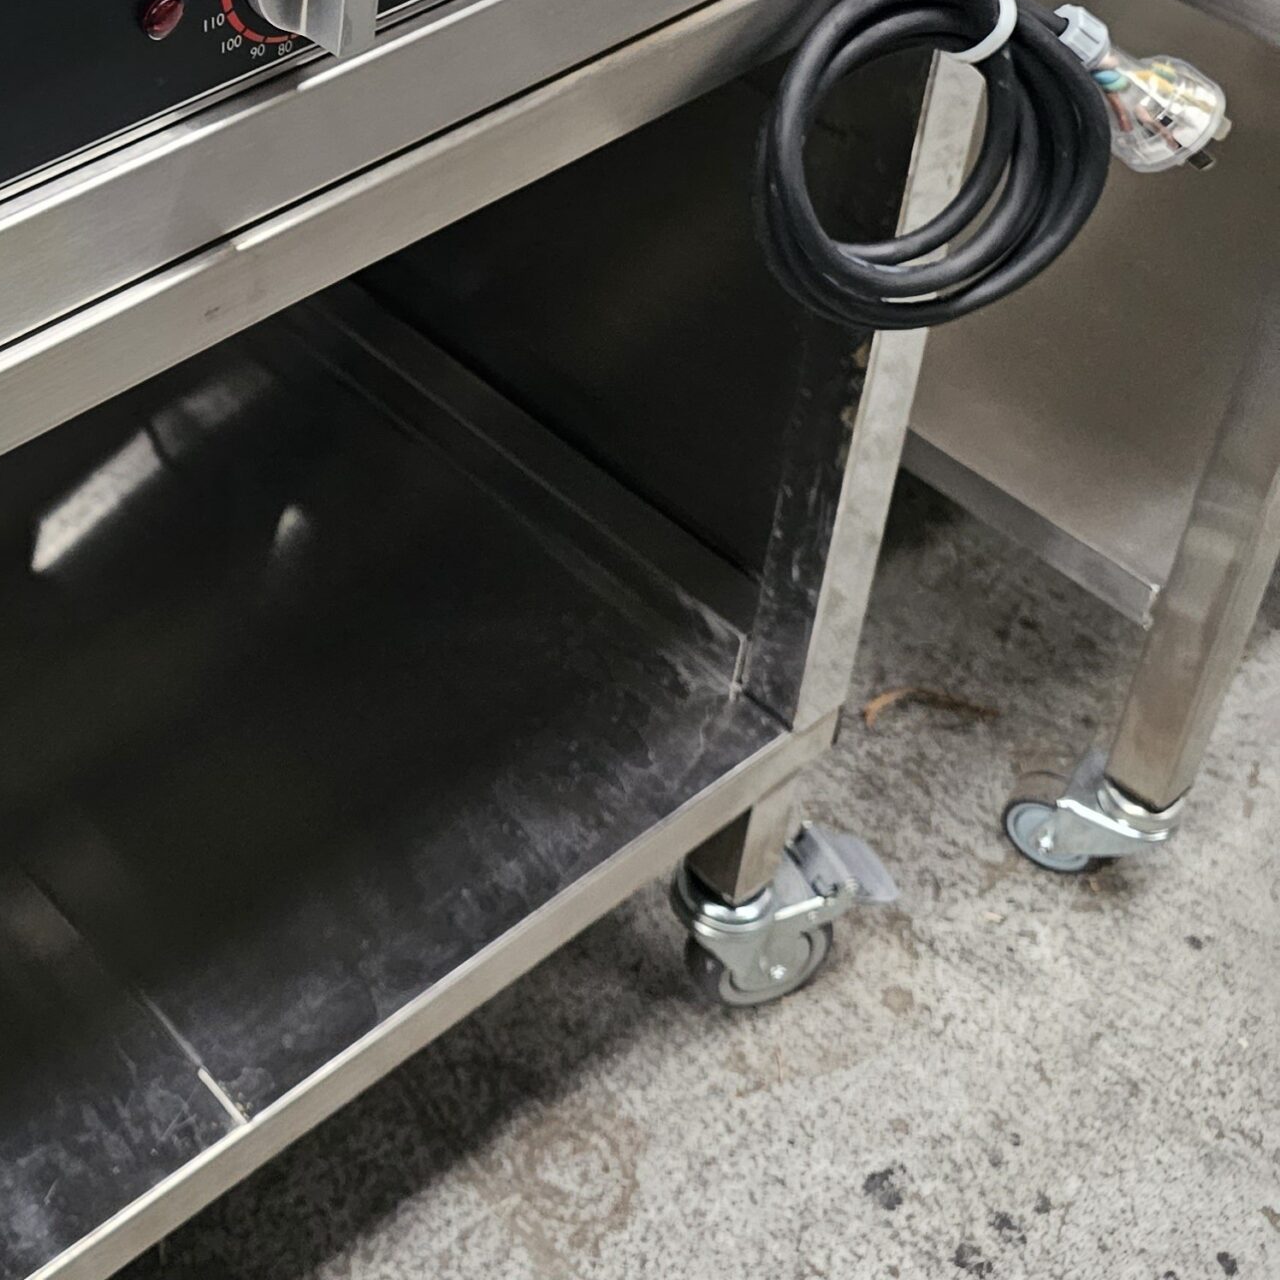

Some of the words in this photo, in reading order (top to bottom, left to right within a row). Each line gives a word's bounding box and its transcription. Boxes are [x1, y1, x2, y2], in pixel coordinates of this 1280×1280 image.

[203, 13, 225, 32] 110
[221, 35, 242, 53] 100
[250, 44, 266, 59] 90
[277, 41, 293, 56] 80
